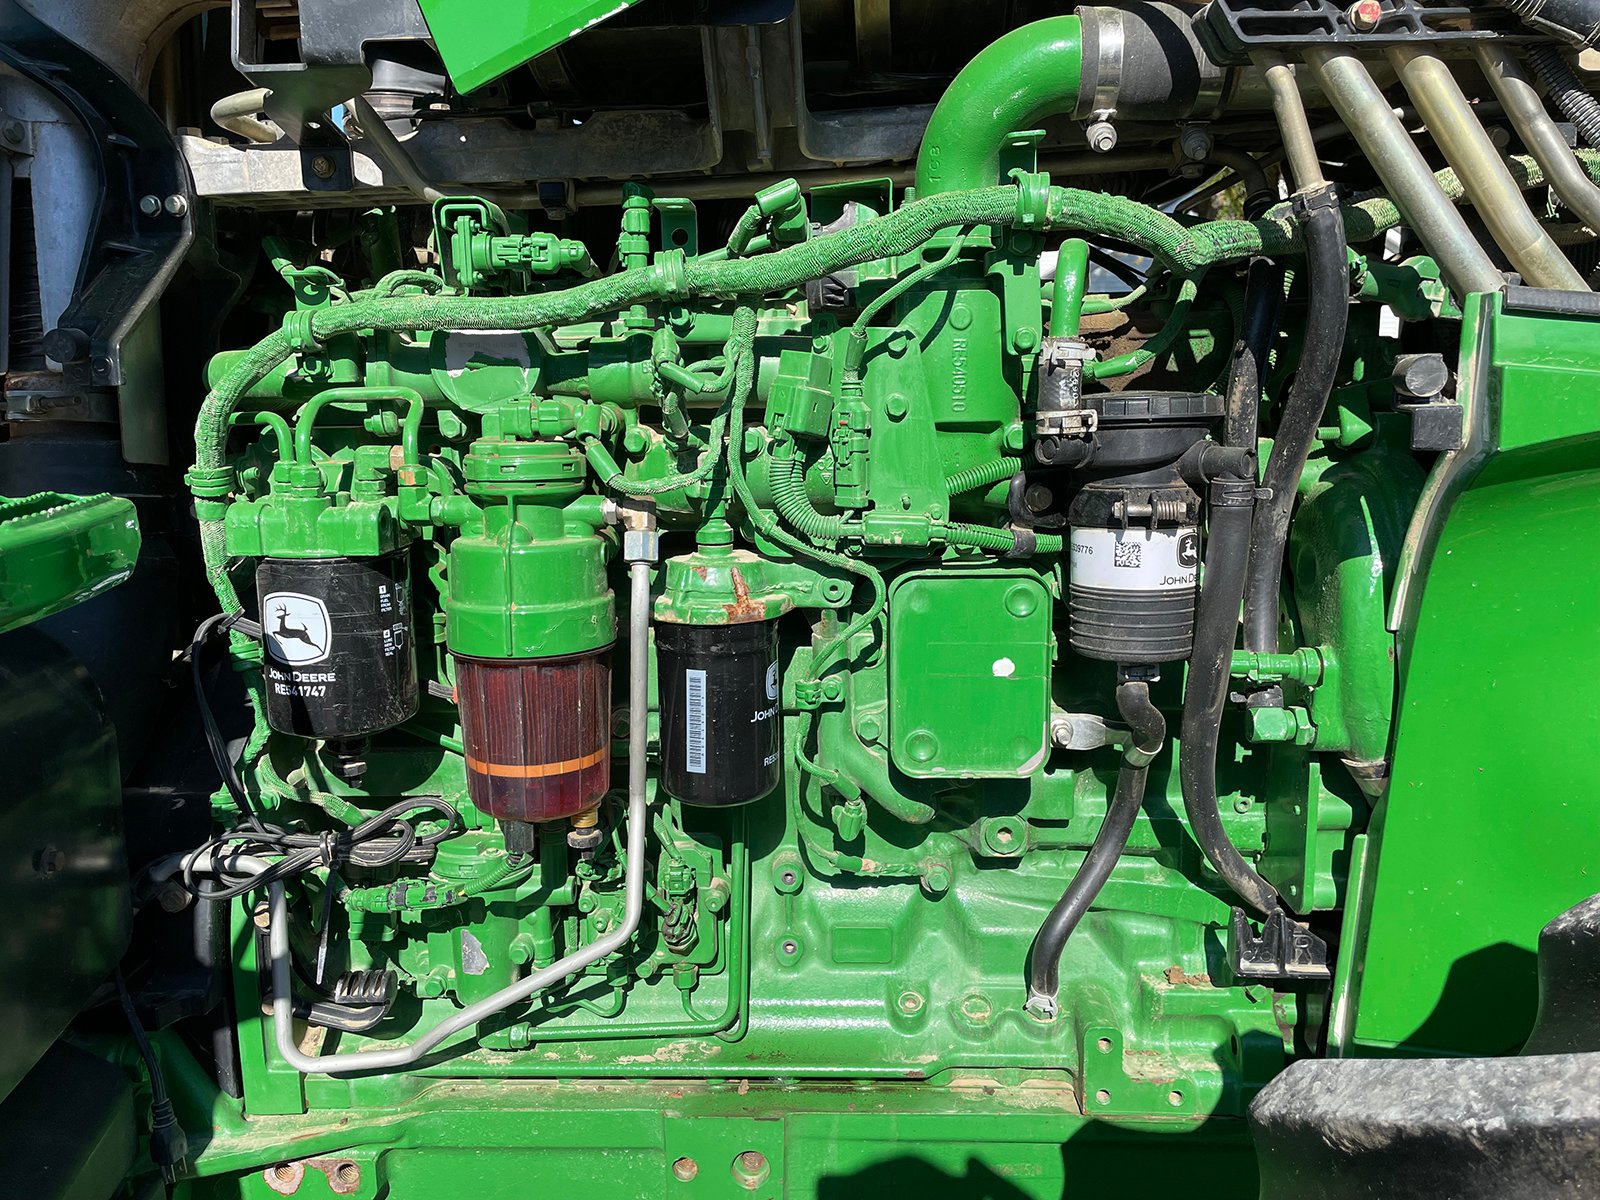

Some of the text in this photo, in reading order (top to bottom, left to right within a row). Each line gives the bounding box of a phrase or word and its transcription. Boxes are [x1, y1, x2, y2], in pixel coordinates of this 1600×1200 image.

[1159, 575, 1188, 586] JOHN
[268, 667, 337, 683] JOHN DEERE
[274, 682, 327, 697] RE541747
[750, 706, 775, 723] JOHN
